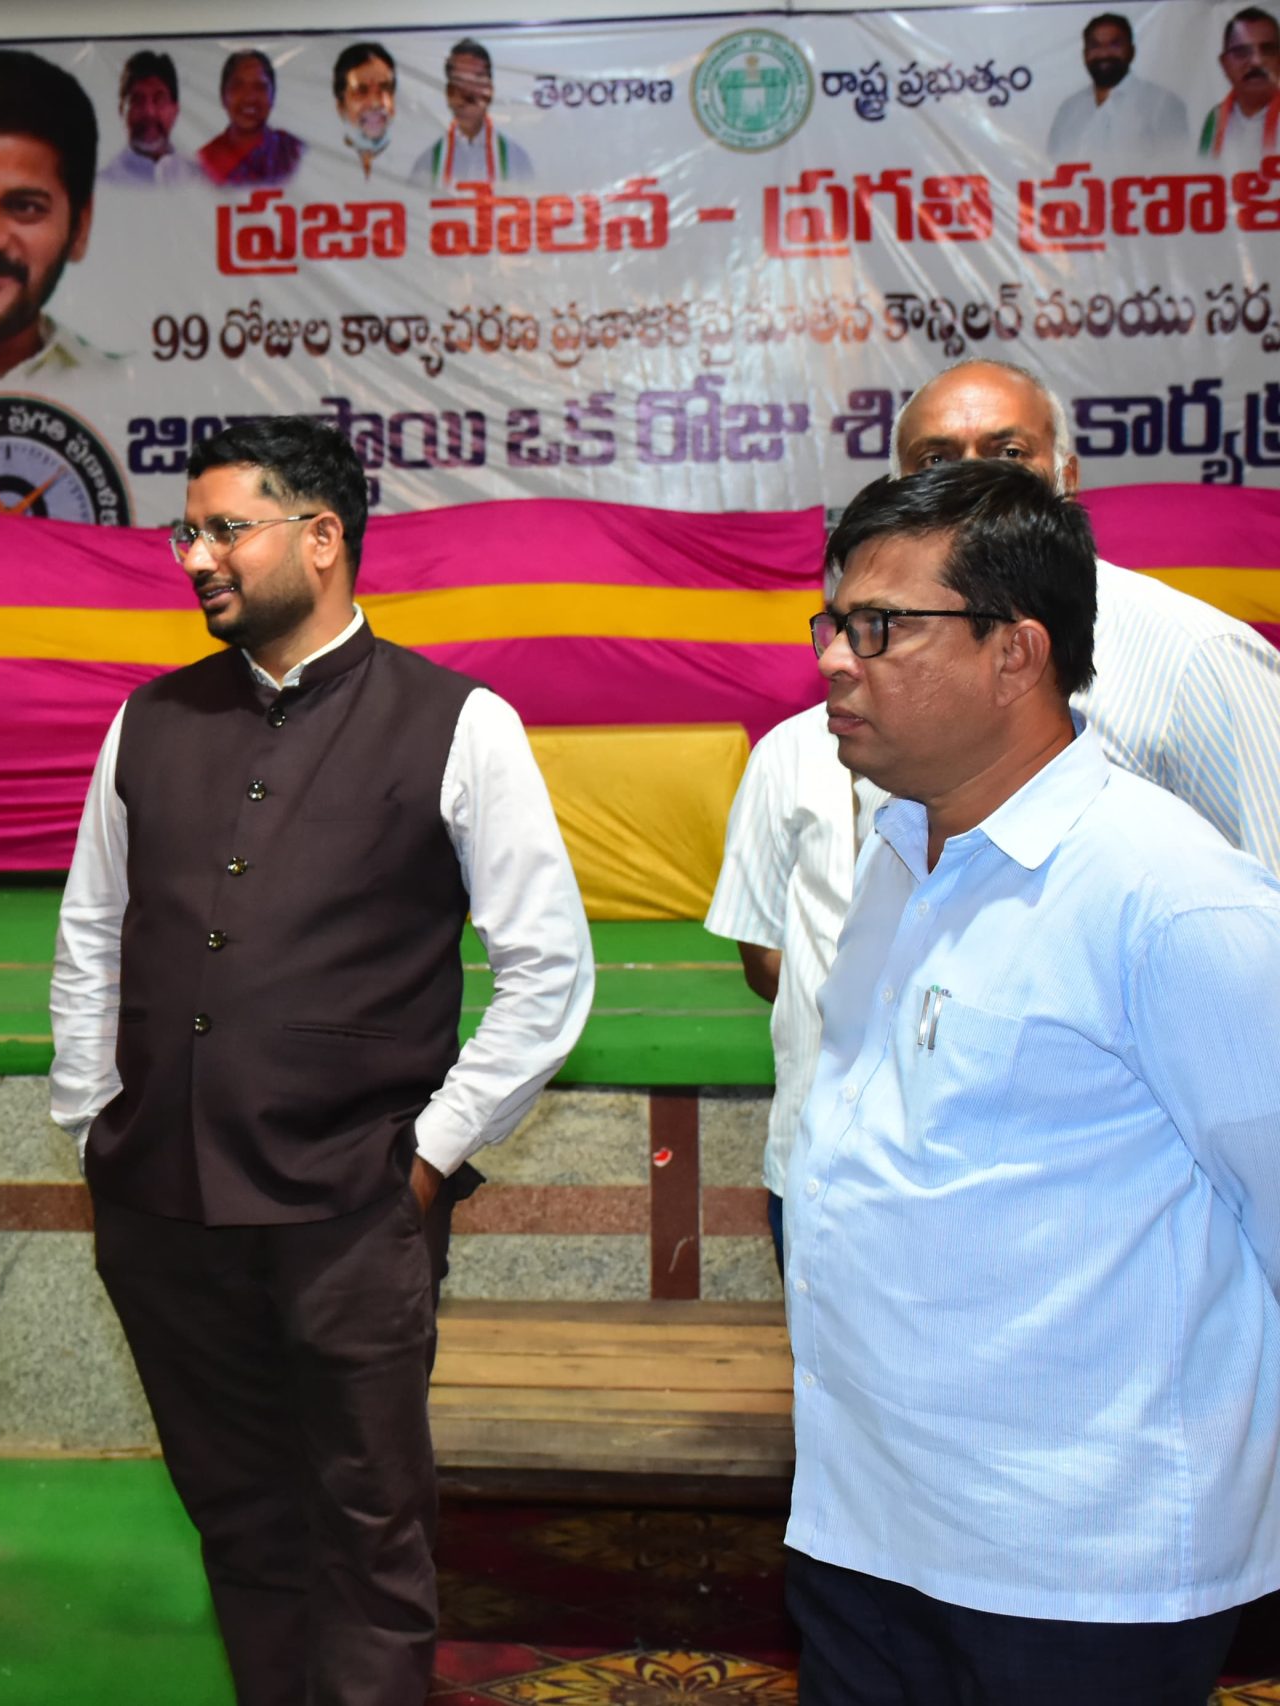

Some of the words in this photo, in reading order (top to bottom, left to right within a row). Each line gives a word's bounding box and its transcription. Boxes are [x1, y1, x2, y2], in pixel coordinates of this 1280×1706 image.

[533, 74, 674, 109] తెలంగాణ
[896, 59, 1032, 108] ప్రభుత్వం
[216, 189, 407, 277] ప్రజా
[427, 177, 670, 257] పాలన
[762, 168, 995, 260] ప్రగతి
[151, 313, 210, 362] 99
[220, 299, 331, 360] రోజుల
[340, 304, 541, 378] కార్యాచరణ
[1033, 284, 1196, 341] మరియు
[506, 391, 617, 468] ఒక
[636, 374, 811, 464] రోజు
